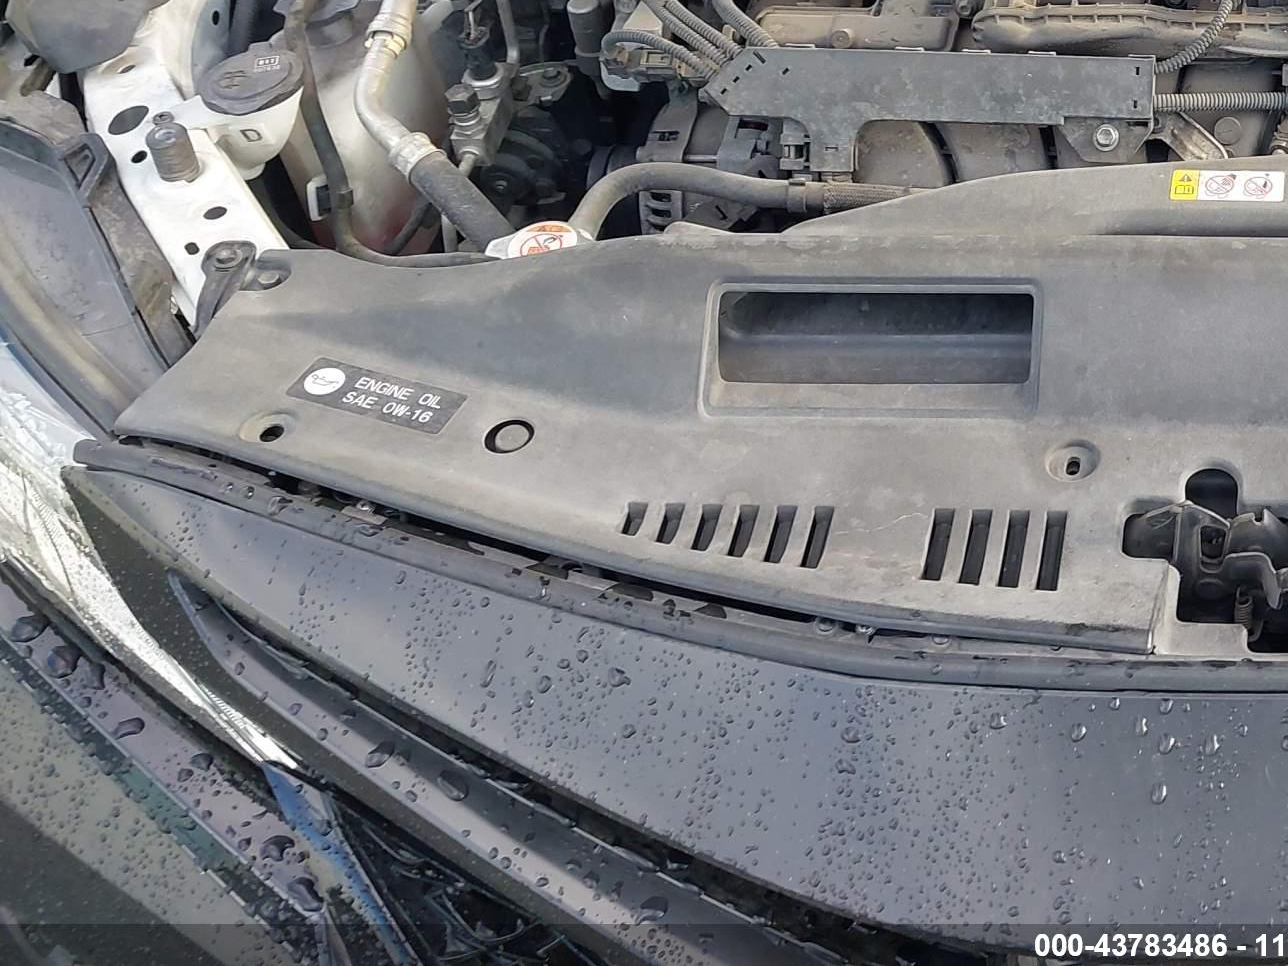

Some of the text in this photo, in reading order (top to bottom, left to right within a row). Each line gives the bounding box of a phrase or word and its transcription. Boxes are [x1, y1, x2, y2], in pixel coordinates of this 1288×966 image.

[341, 391, 433, 424] SAE 0W-16
[354, 376, 442, 409] ENGINE OIL
